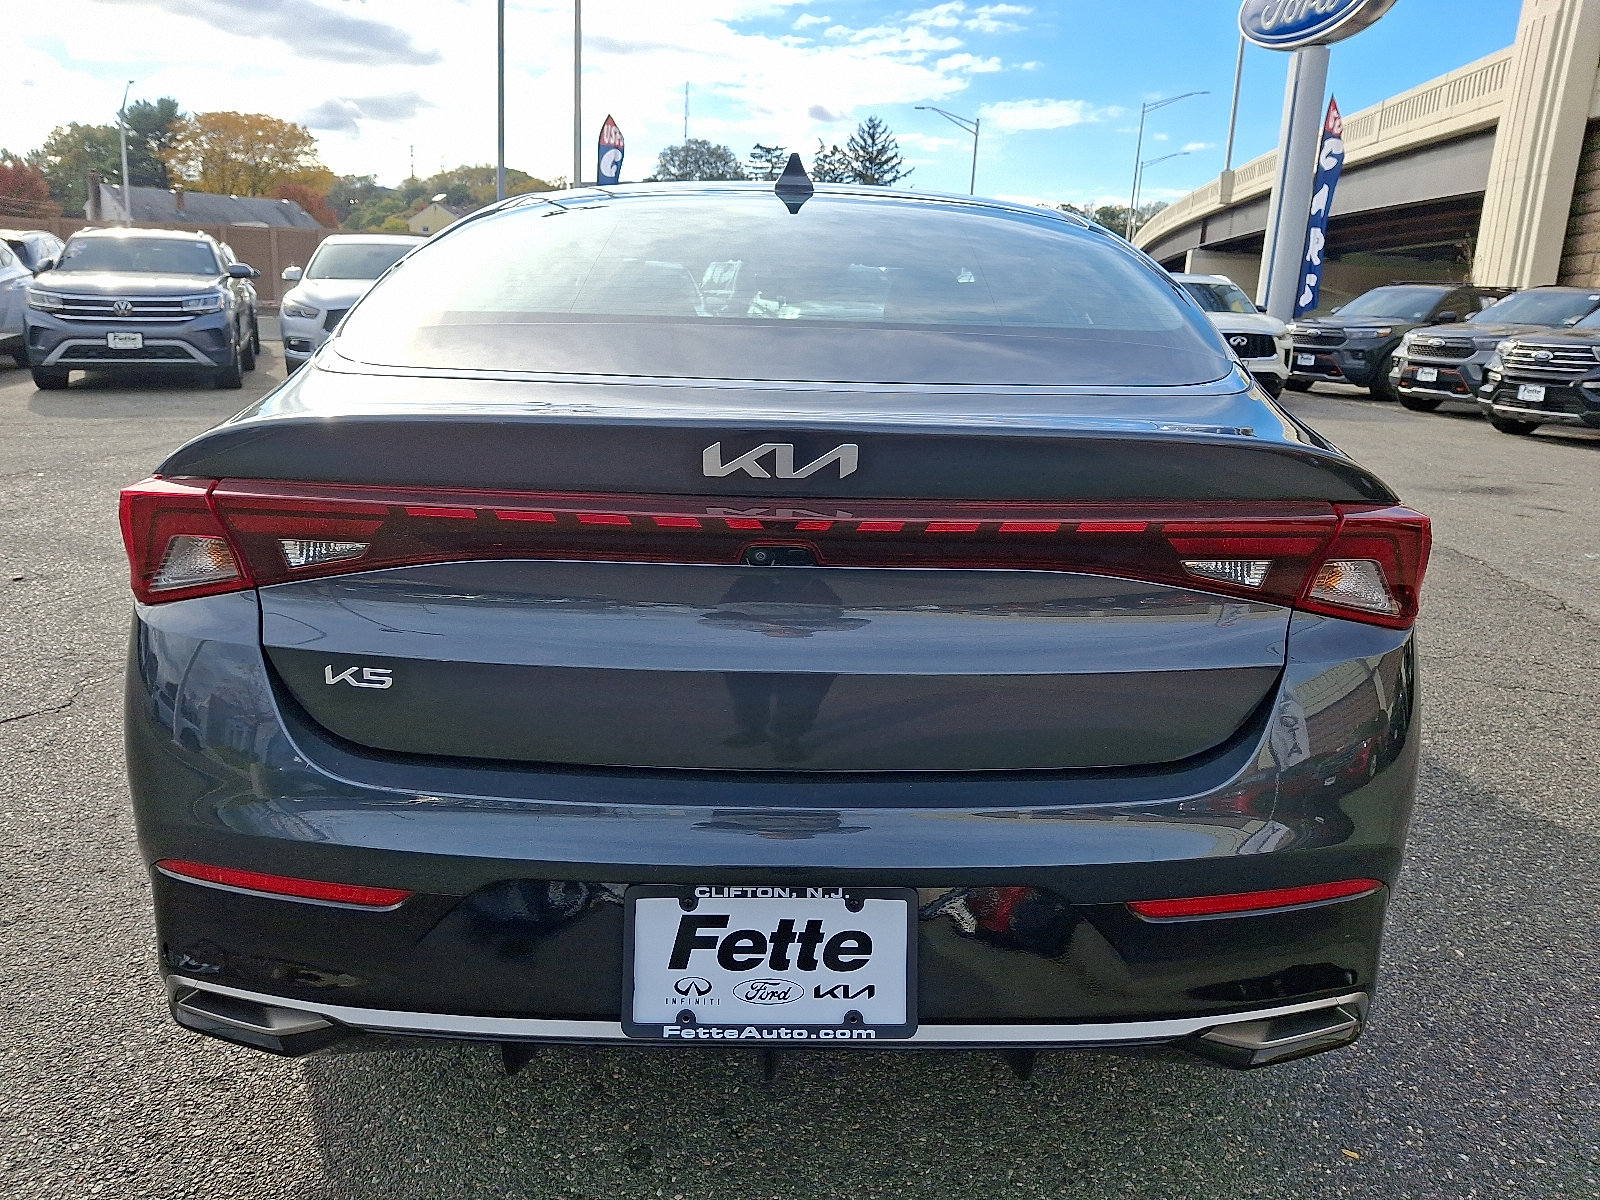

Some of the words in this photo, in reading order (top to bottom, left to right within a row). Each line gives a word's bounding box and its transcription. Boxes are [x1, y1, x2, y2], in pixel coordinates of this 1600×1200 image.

[1261, 0, 1341, 30] or
[702, 441, 859, 479] KIA
[324, 664, 393, 689] K5
[694, 886, 797, 899] CLIFTON,
[806, 887, 850, 899] N.J.
[667, 914, 873, 972] Fette
[744, 981, 792, 1001] Ford
[813, 983, 876, 1000] KIA
[665, 997, 721, 1006] INFINITI
[662, 1025, 876, 1039] FetteAuto.com
